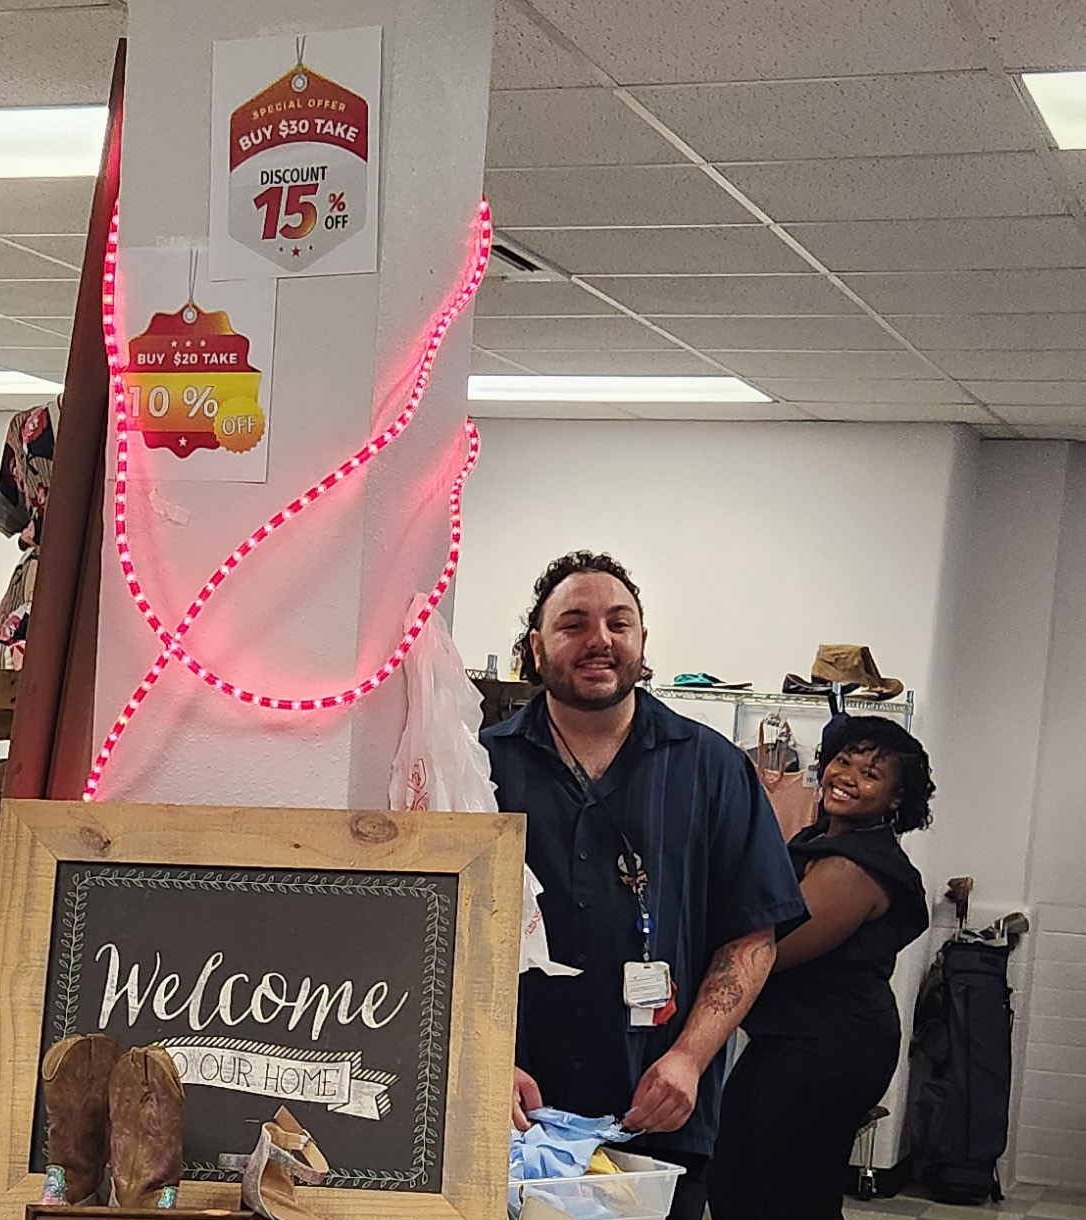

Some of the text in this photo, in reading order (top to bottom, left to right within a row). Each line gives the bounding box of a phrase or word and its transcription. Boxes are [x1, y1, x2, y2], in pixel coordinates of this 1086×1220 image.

[252, 98, 346, 120] SPECIAL OFFER
[238, 118, 359, 151] BUY $30 TAKE
[260, 166, 328, 185] DISCOUNT
[252, 182, 346, 240] 15 %
[324, 214, 349, 230] OFF
[137, 351, 238, 367] BUY $20 TAKE
[128, 385, 219, 418] 10 %
[222, 415, 256, 436] OFF
[95, 943, 409, 1041] Welcome
[200, 1053, 253, 1087] OUR
[264, 1063, 339, 1097] HOME
